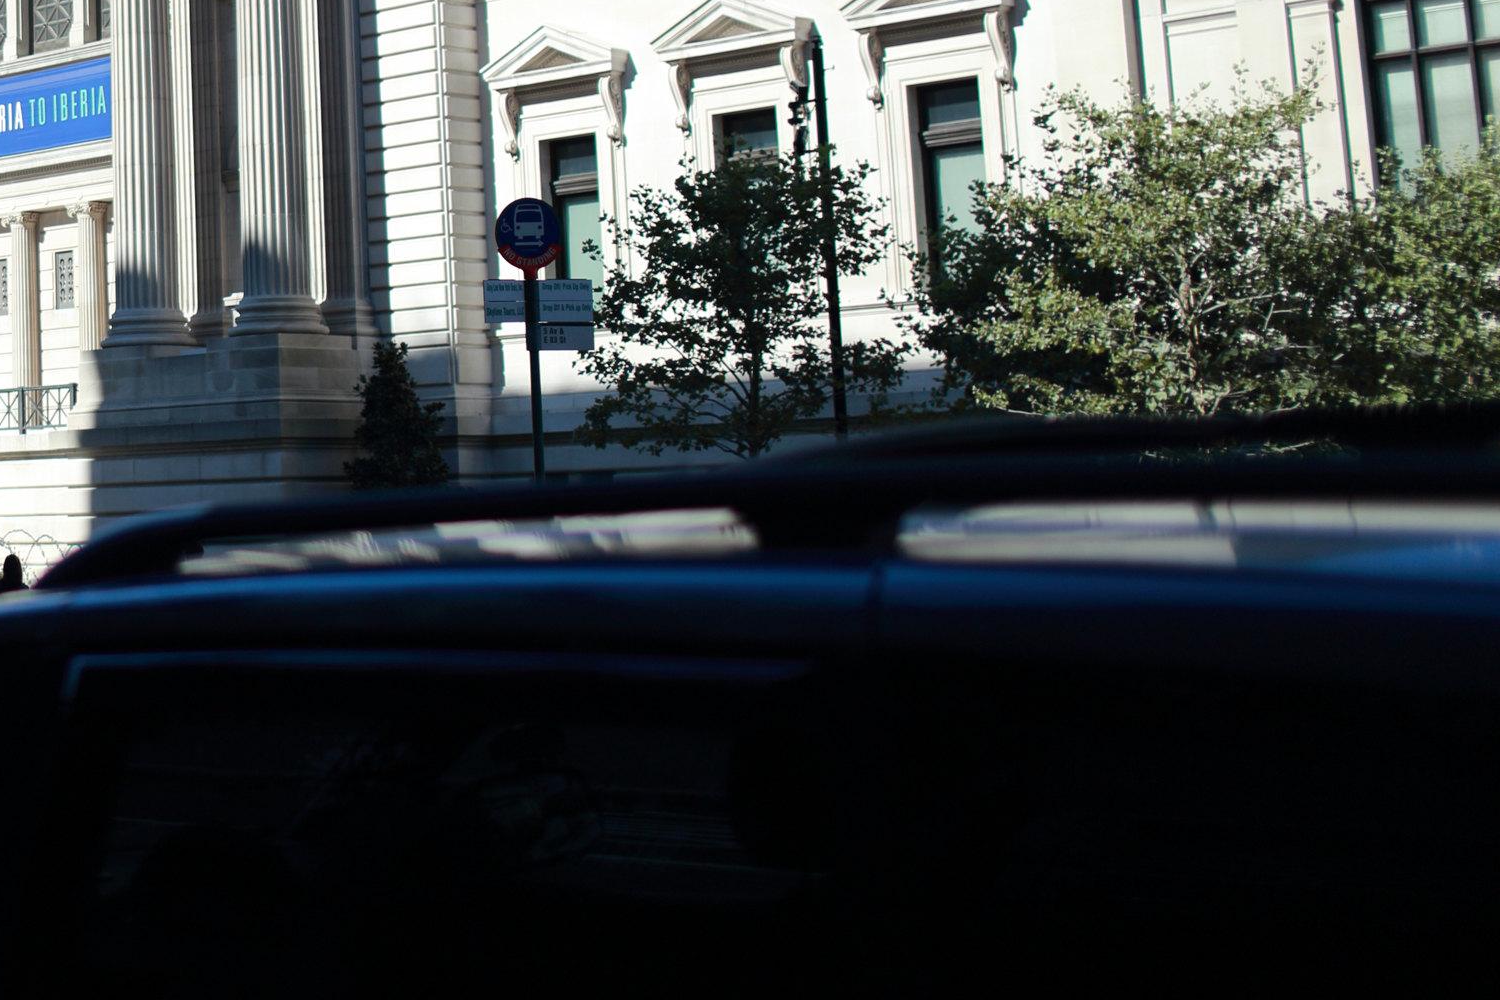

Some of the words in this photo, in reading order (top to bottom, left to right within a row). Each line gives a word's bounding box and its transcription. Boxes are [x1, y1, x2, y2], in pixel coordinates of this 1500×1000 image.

[28, 97, 46, 127] TO
[53, 85, 107, 123] IBERIA
[503, 247, 516, 261] NO
[516, 247, 556, 265] STANDING
[542, 304, 553, 313] Drop
[565, 304, 574, 312] Pick
